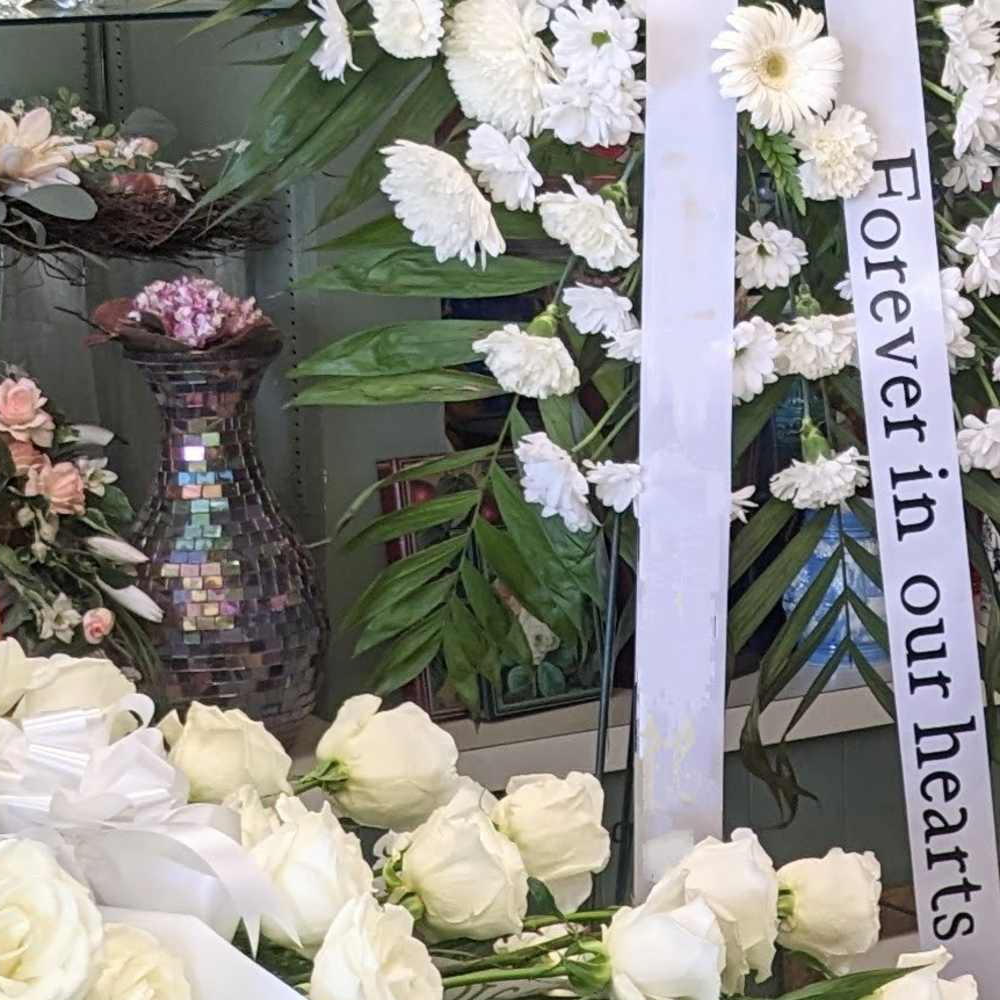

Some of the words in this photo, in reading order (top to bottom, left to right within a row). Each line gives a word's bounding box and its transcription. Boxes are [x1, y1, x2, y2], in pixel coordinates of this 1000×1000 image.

[860, 148, 927, 443] Forever
[889, 464, 949, 541] in
[900, 574, 950, 698] our
[913, 715, 982, 941] hearts
